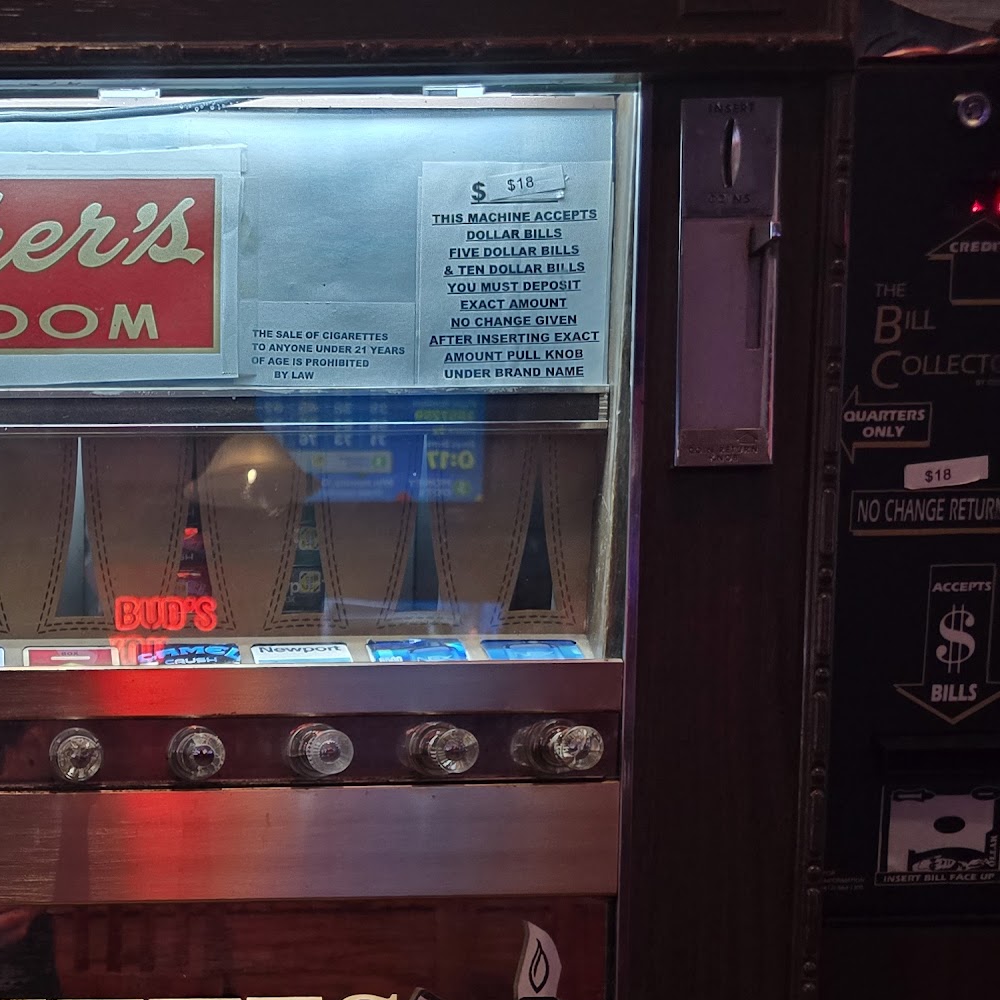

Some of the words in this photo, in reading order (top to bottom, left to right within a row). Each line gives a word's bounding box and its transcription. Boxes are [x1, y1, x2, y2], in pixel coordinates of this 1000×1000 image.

[708, 103, 755, 113] INSERT
[507, 176, 535, 192] $18
[471, 181, 486, 202] $
[432, 214, 463, 224] THIS
[468, 212, 530, 223] MACHINE
[534, 209, 597, 221] ACCEPTS
[466, 229, 519, 240] DOLLAR
[524, 228, 562, 239] BILLS
[449, 247, 480, 258] FIVE
[484, 246, 536, 257] DOLLAR
[541, 245, 580, 255] BILLS
[444, 266, 453, 275] &
[458, 265, 485, 275] TEN
[489, 264, 543, 275] DOLLAR
[547, 262, 585, 272] BILLS
[447, 283, 476, 293] YOU
[481, 281, 519, 292] MUST
[523, 279, 581, 291] DEPOSIT
[875, 282, 907, 298] THE
[460, 299, 505, 310] EXACT
[509, 298, 567, 309] AMOUNT
[451, 317, 470, 327] NO
[475, 316, 531, 327] CHANGE
[535, 315, 577, 326] GIVEN
[252, 330, 273, 338] THE
[276, 330, 303, 339] SALE
[305, 331, 320, 339] OF
[322, 331, 389, 341] CIGARETTES
[429, 335, 473, 345] AFTER
[477, 333, 550, 344] INSERTING
[554, 331, 600, 342] EXACT
[252, 343, 266, 351] TO
[268, 344, 313, 353] ANYONE
[315, 345, 352, 354] UNDER
[354, 346, 367, 354] 21
[370, 346, 405, 355] YEARS
[444, 351, 503, 362] AMOUNT
[507, 350, 541, 361] PULL
[545, 349, 584, 359] KNOB
[251, 356, 266, 365] OF
[267, 357, 290, 366] AGE
[292, 358, 303, 366] IS
[305, 358, 370, 367] PROHIBITED
[274, 371, 289, 379] BY
[291, 371, 314, 380] LAW
[444, 369, 491, 379] UNDER
[495, 367, 541, 378] BRAND
[545, 366, 584, 377] NAME
[843, 409, 926, 422] QUARTERS
[862, 425, 905, 438] ONLY
[924, 468, 951, 483] $18
[857, 500, 880, 522] NO
[884, 498, 946, 522] CHANGE
[932, 581, 992, 593] ACCEPTS
[114, 595, 217, 631] BUD'S
[935, 603, 976, 674] $
[258, 644, 342, 655] Newport
[164, 656, 218, 665] CRUSH
[930, 684, 978, 702] BILLS
[883, 874, 920, 883] INSERT
[924, 874, 947, 882] BILL
[950, 873, 977, 881] FACE
[980, 872, 996, 880] UP
